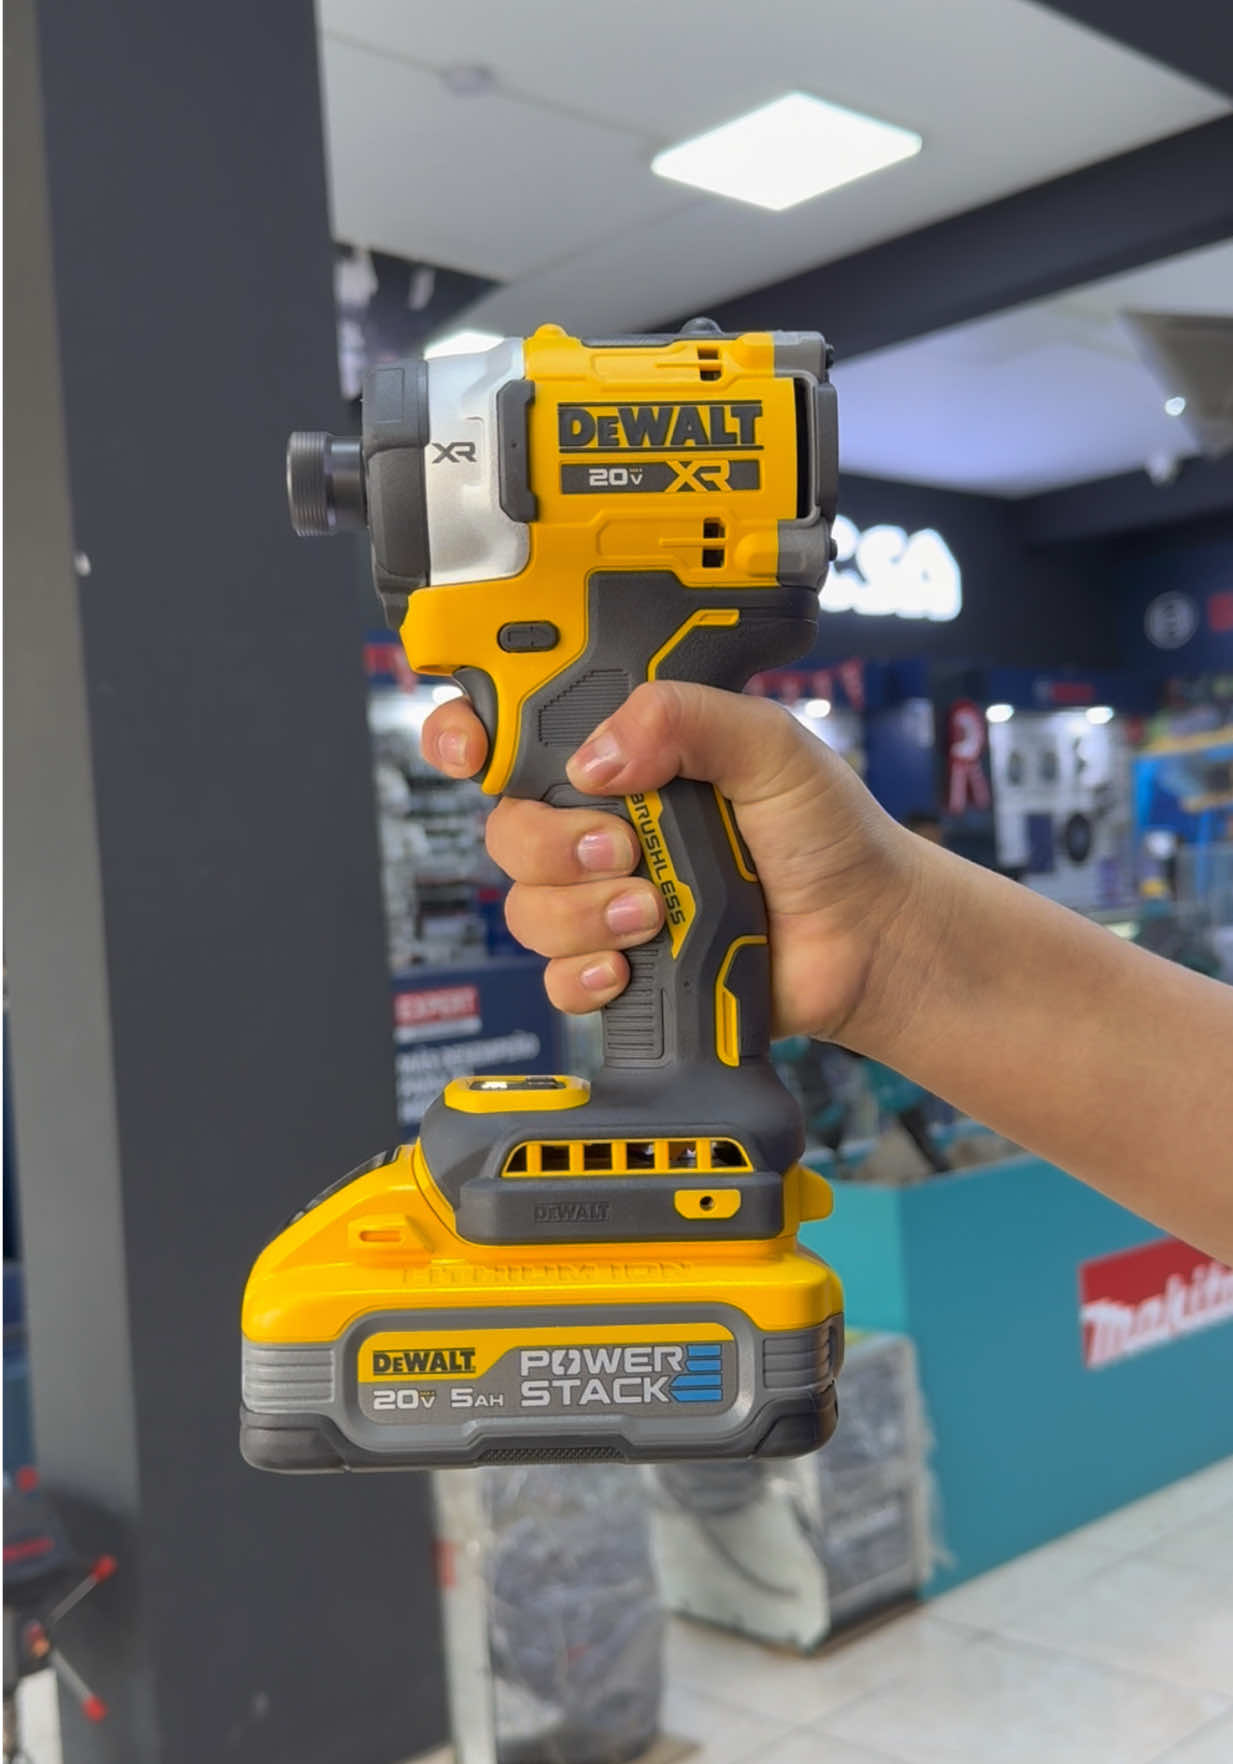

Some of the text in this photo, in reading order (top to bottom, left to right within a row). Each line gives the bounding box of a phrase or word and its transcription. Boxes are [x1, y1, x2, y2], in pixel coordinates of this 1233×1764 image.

[558, 404, 762, 447] DEWALT
[431, 441, 477, 463] XR
[664, 459, 733, 492] XR
[535, 1202, 609, 1223] DEWALT
[372, 1349, 477, 1374] DEWALT
[520, 1346, 683, 1376] POWER
[520, 1376, 670, 1407] STACK
